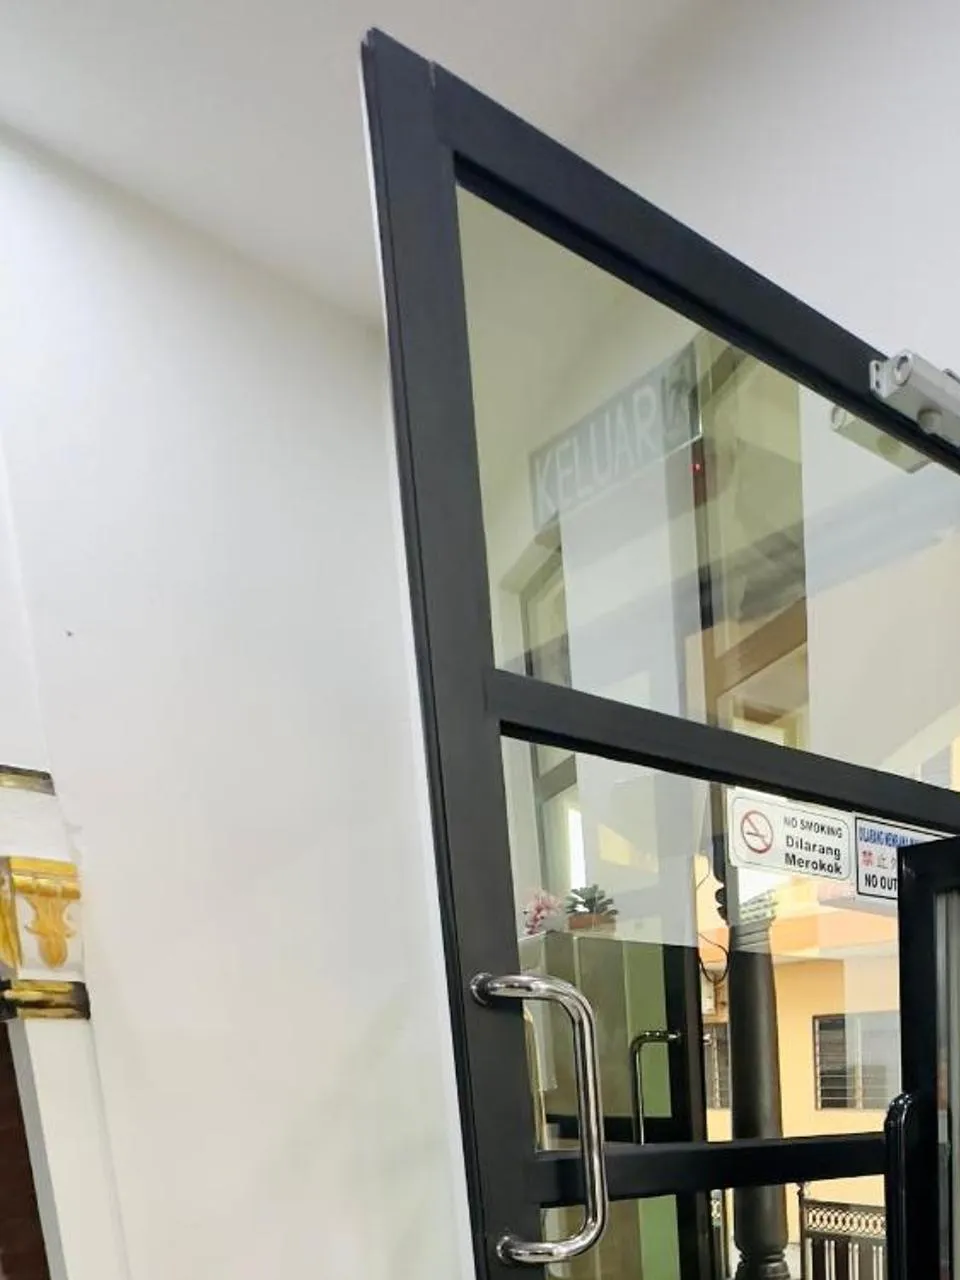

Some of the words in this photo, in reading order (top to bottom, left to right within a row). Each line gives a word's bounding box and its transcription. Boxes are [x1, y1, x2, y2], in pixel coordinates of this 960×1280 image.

[784, 816, 798, 828] NO
[800, 819, 842, 838] SMOKING
[786, 835, 841, 861] Dilarang
[785, 853, 842, 874] Merokok
[865, 874, 877, 888] NO
